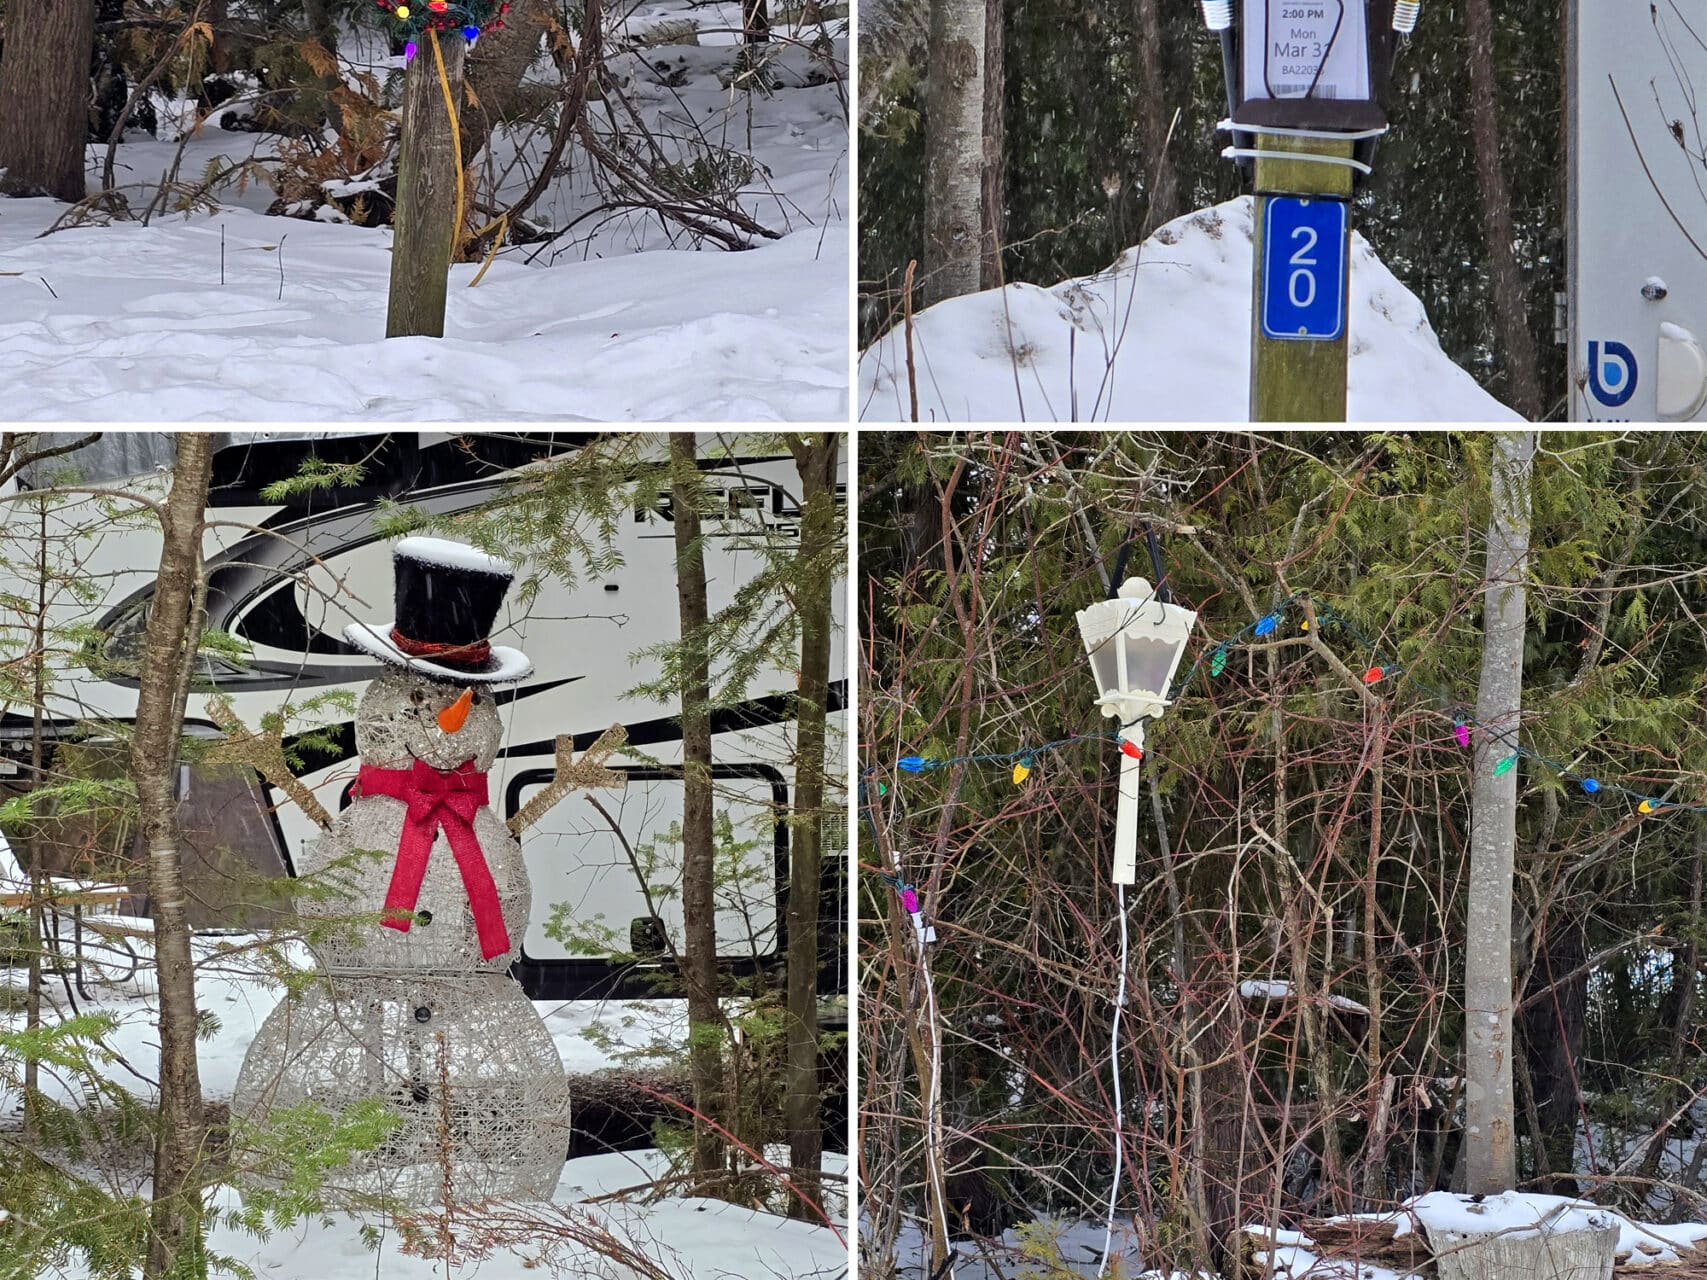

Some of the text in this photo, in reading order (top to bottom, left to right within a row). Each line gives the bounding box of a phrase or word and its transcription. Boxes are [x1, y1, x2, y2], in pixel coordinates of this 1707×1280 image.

[1282, 9, 1324, 19] 2:00 PM
[1290, 28, 1317, 40] Mon
[1274, 41, 1308, 58] Mar
[1288, 226, 1318, 308] 20
